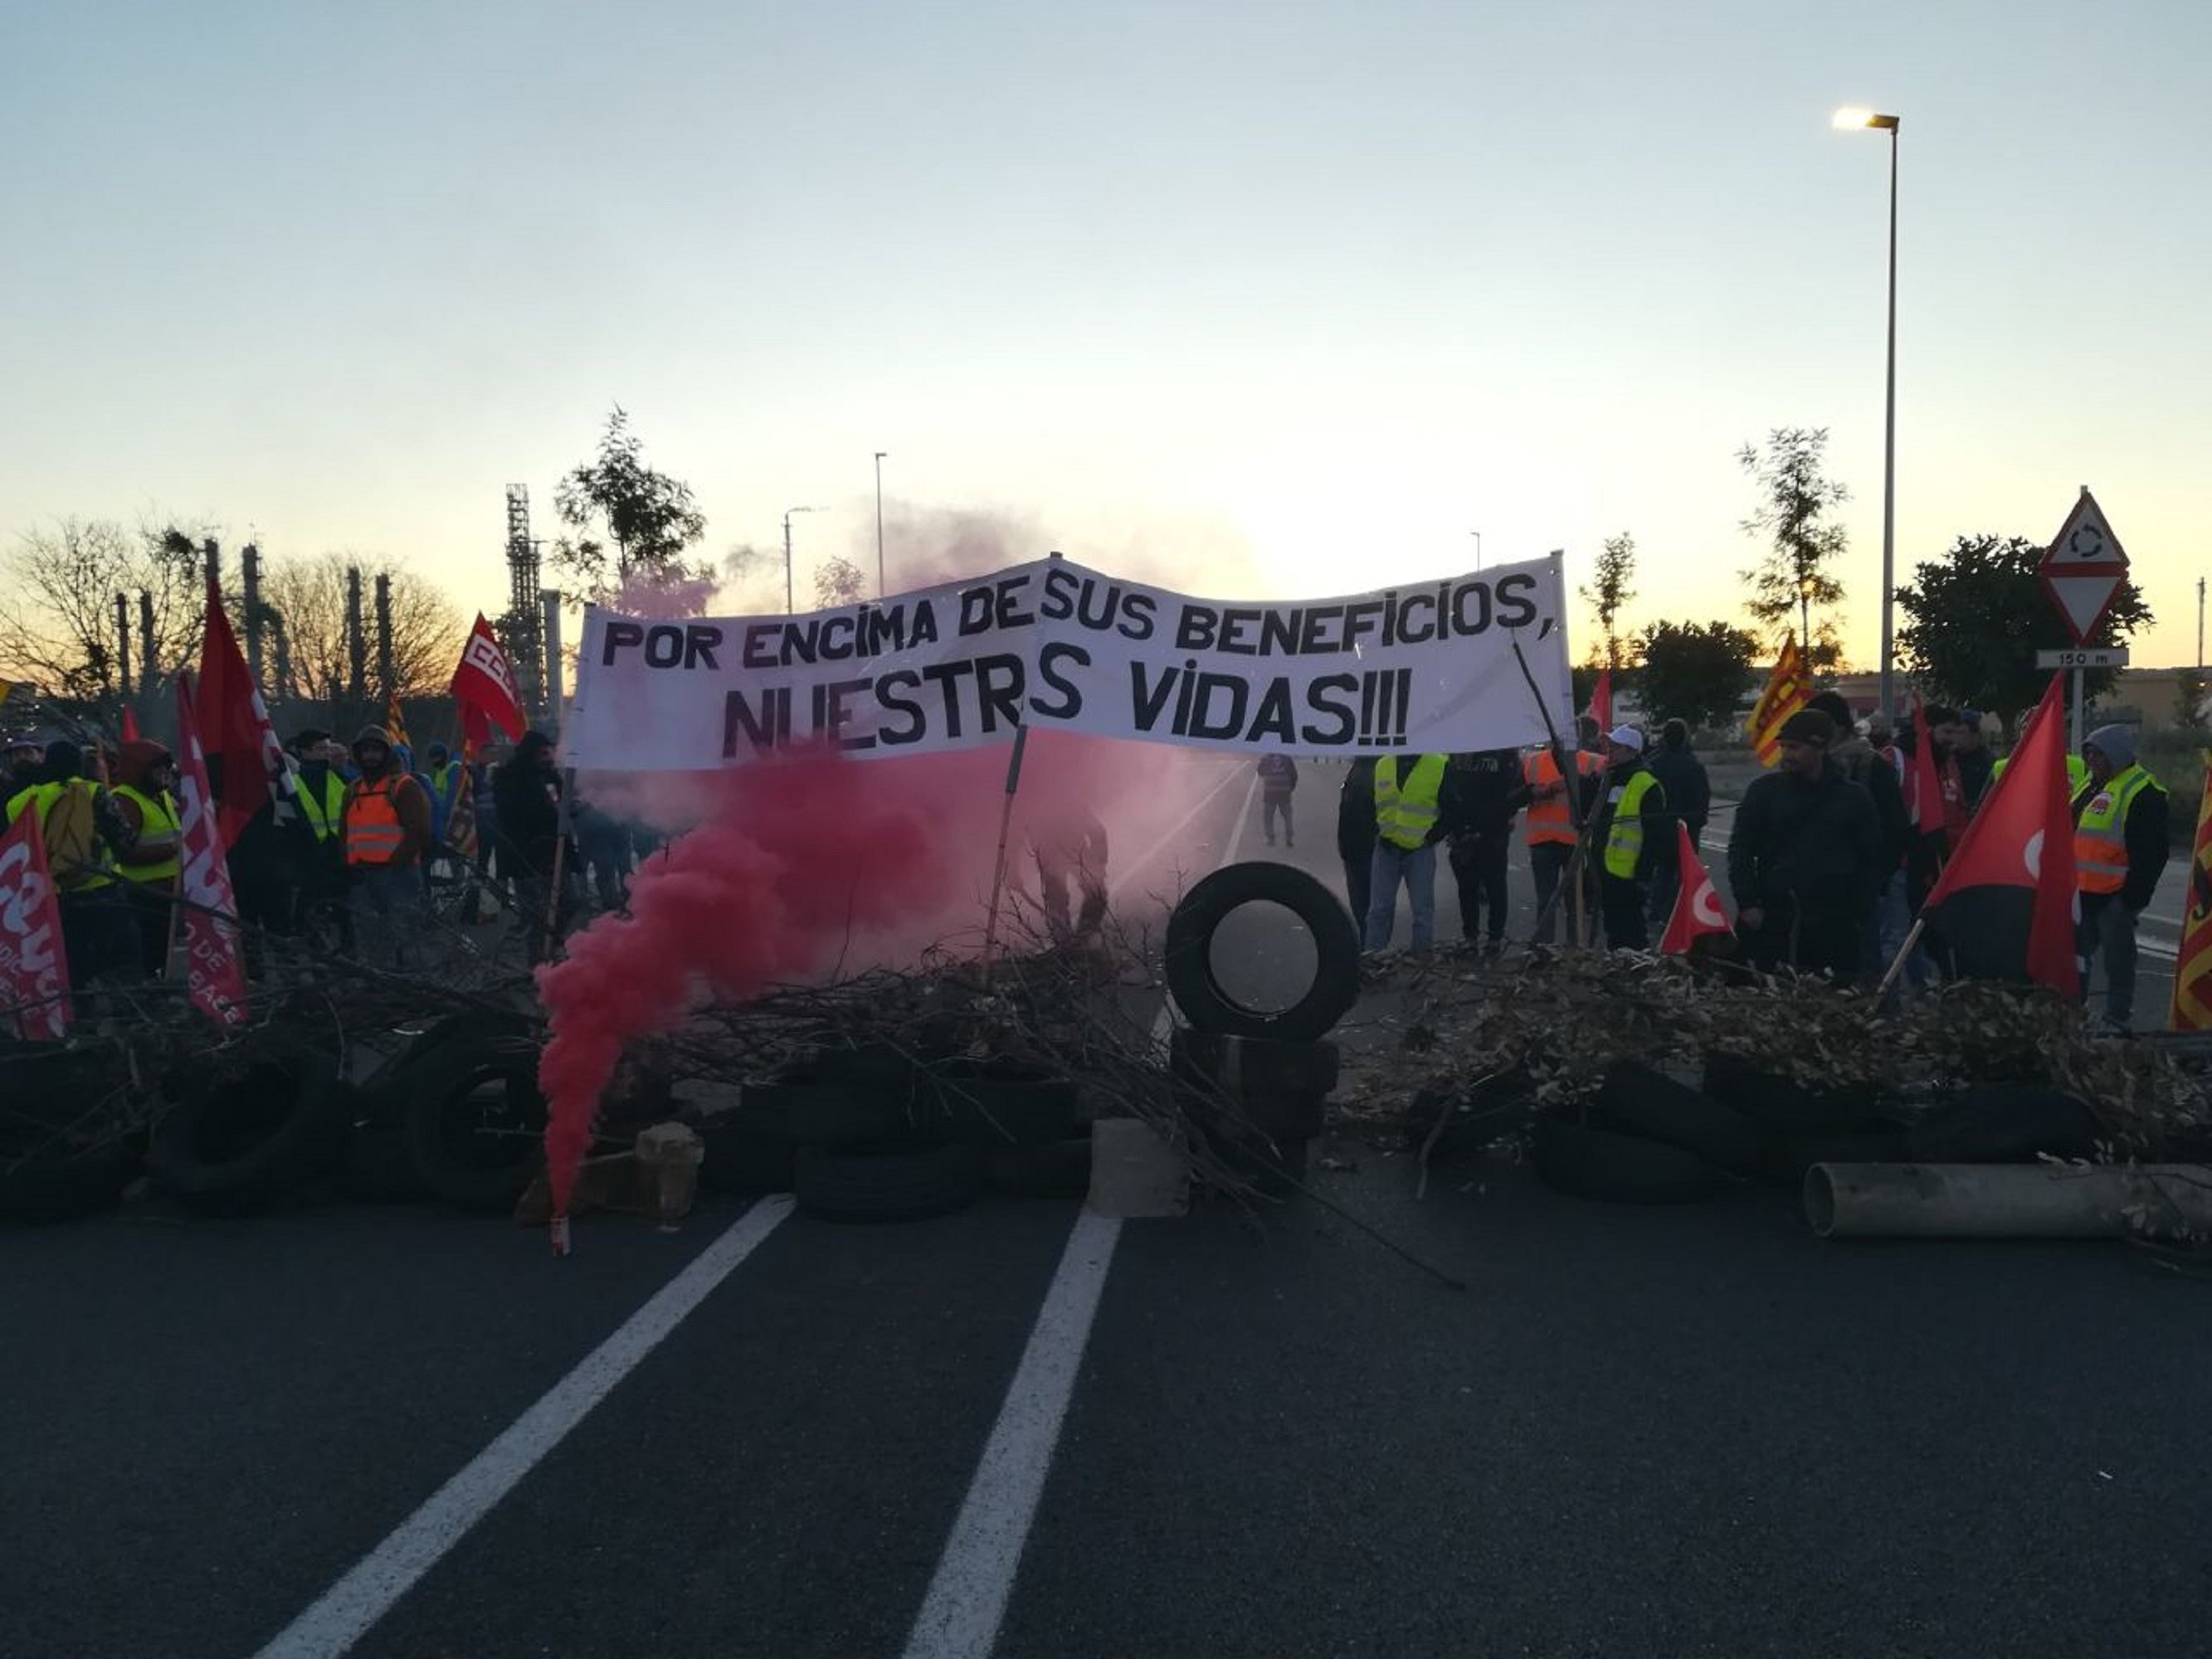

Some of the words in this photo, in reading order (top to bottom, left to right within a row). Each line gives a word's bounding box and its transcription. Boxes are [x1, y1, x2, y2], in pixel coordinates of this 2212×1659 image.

[602, 621, 724, 670] POR
[959, 575, 1035, 637] DE
[1040, 567, 1157, 641] SUS
[2060, 653, 2087, 664] 150
[2096, 654, 2107, 664] m
